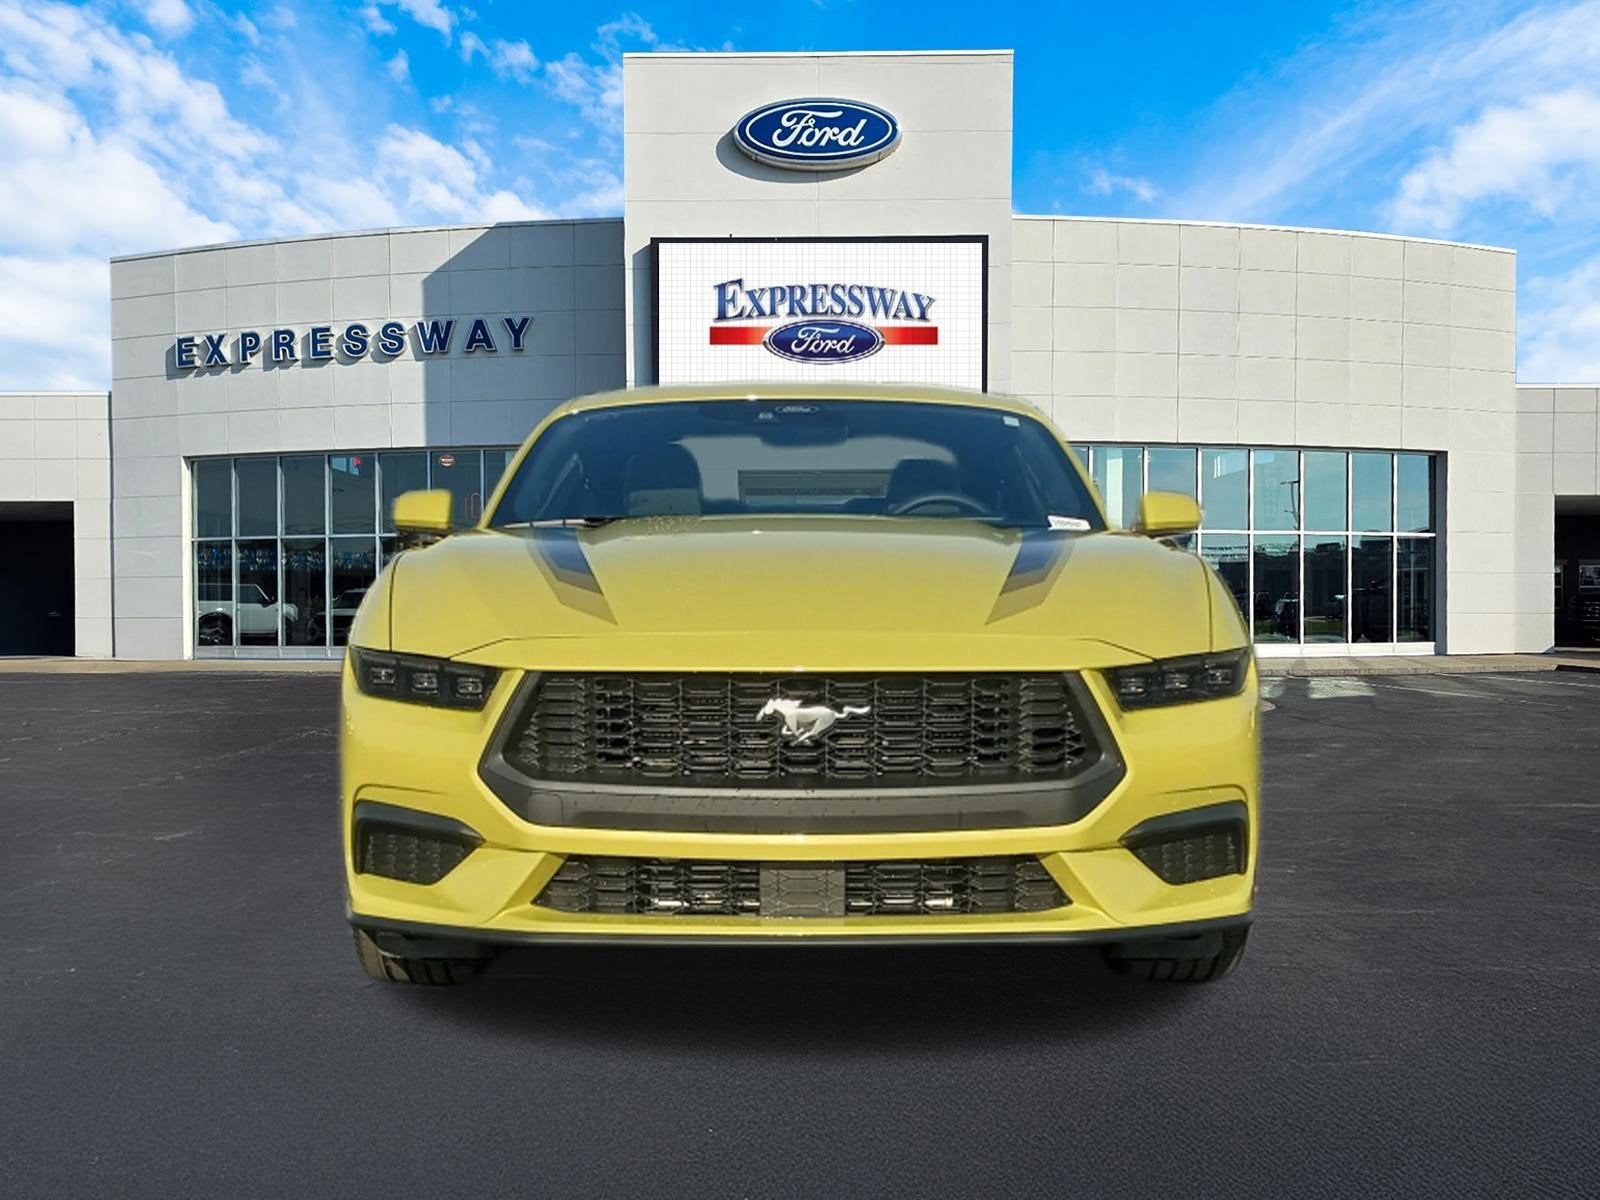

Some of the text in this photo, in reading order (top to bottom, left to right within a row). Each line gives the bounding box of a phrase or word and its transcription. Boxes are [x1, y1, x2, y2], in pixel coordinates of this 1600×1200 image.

[771, 109, 867, 148] Ford
[713, 278, 935, 322] EXPRESSWAY
[175, 316, 533, 368] EXPRESSWAY
[791, 326, 855, 354] Ford
